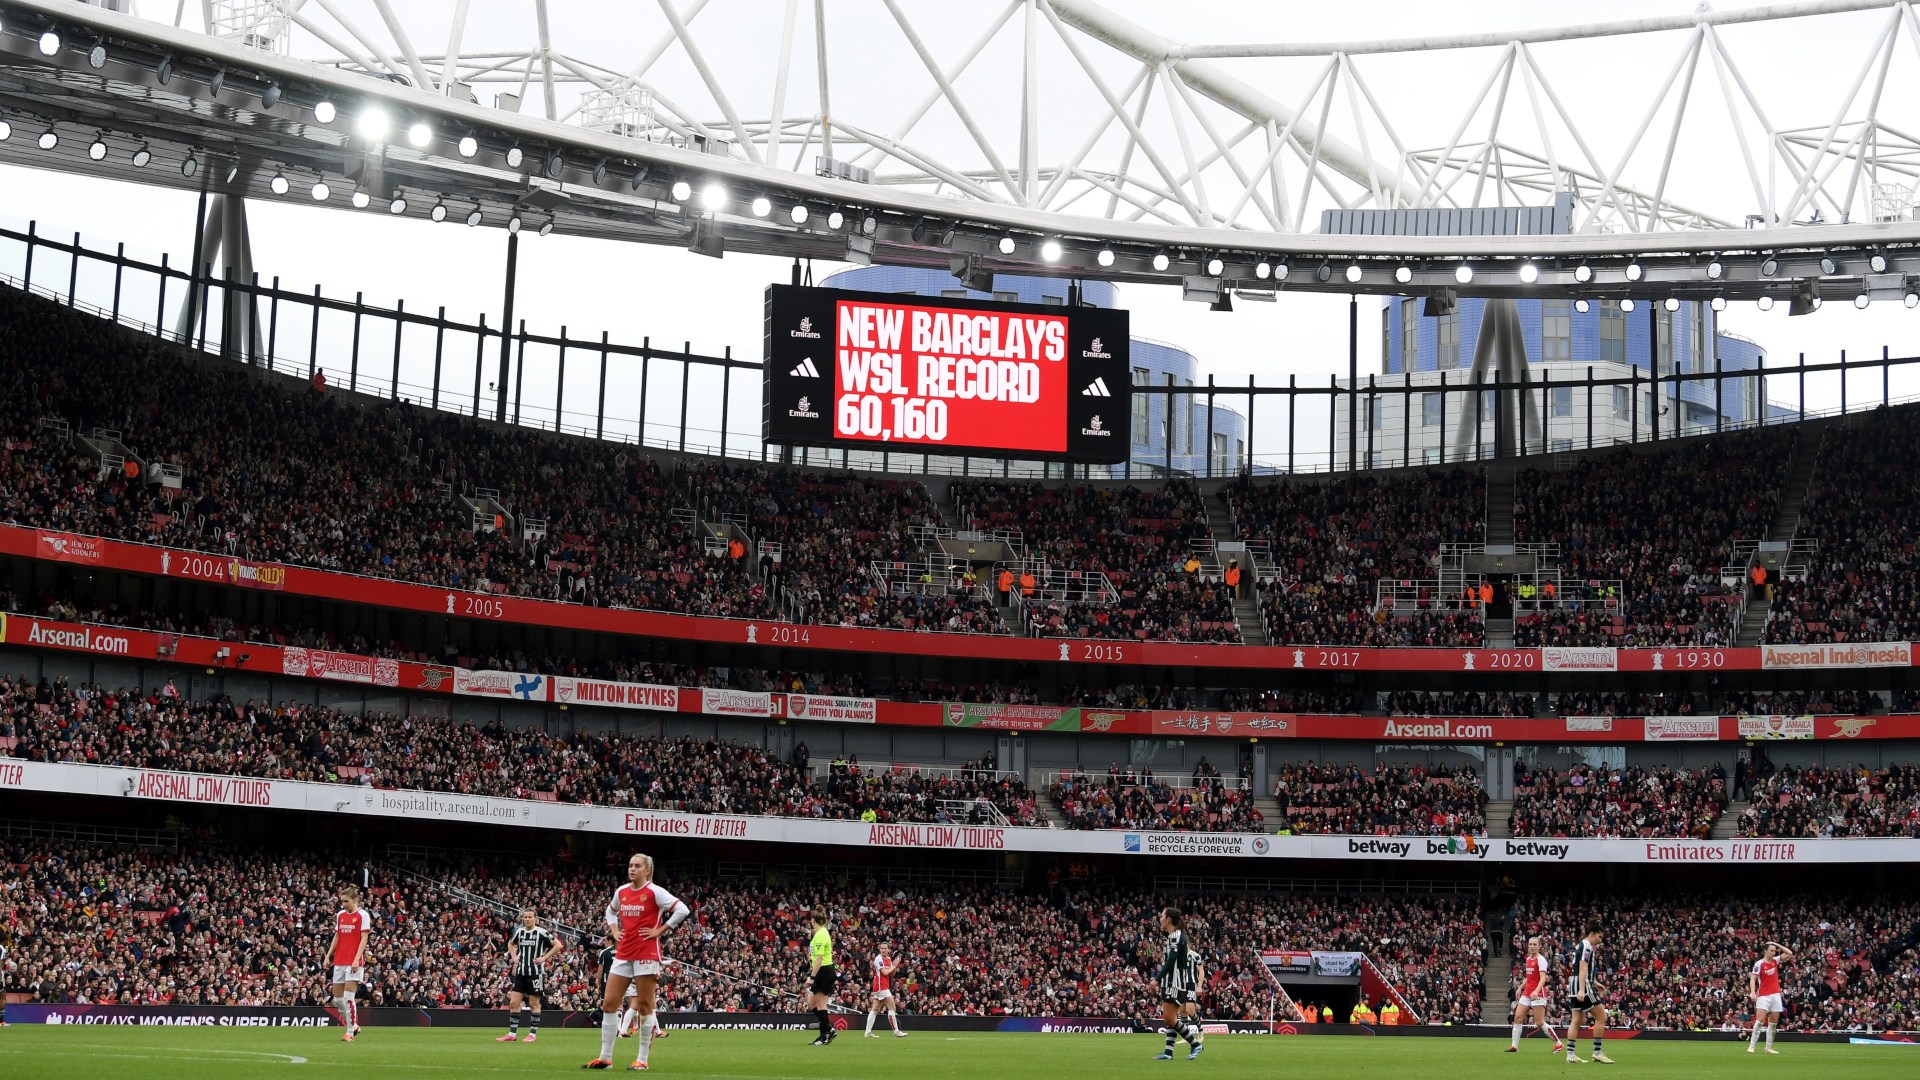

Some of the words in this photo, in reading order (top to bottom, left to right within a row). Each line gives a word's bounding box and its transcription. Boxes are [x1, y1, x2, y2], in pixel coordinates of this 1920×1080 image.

[790, 329, 821, 339] Emirates
[839, 305, 905, 350] NEW
[912, 311, 1065, 361] BARCLAYS
[1082, 349, 1112, 359] Emirates
[840, 350, 908, 395] WSL
[917, 355, 1040, 403] RECORD
[789, 409, 819, 419] Emirates
[837, 393, 948, 441] 60,160
[1081, 427, 1111, 437] Emirates
[71, 541, 95, 550] JEWISH
[71, 549, 100, 558] GOONERS
[181, 556, 224, 579] 2004
[239, 565, 257, 580] YOURS
[465, 597, 503, 618] 2005
[28, 622, 129, 653] Arsenal.com
[771, 627, 810, 643] 2014
[1084, 645, 1123, 660] 2015
[1319, 651, 1360, 667] 2017
[1490, 653, 1534, 668] 2020
[1562, 649, 1614, 663] Arsenal
[1676, 652, 1724, 667] 1930
[1765, 648, 1825, 665] Arsenal
[326, 654, 373, 675] Arsenal
[470, 670, 512, 688] Arsenal
[577, 681, 625, 703] MILTON
[628, 686, 676, 707] KEYNES
[721, 692, 769, 709] Arsenal
[808, 698, 834, 707] ARSENAL
[835, 700, 852, 708] SOUTH
[854, 701, 874, 709] AFRICA
[809, 708, 827, 717] WITH
[829, 709, 843, 718] YOU
[845, 710, 874, 720] ALWAYS
[969, 705, 1006, 717] ARSENAL
[1007, 707, 1062, 719] BANGLADESH
[1161, 714, 1212, 732] 一生槍手
[1236, 716, 1288, 730] 一世紅白
[1384, 720, 1493, 738] Arsenal.com
[1663, 718, 1718, 733] Arsenal
[1740, 721, 1766, 729] ARSENAL
[1785, 721, 1812, 729] JAMAICA
[138, 772, 271, 806] ARSENAL.COM/TOURS
[382, 794, 515, 820] hospitality.arsenal.com
[625, 813, 690, 834] Emirates
[695, 817, 712, 835] FLY
[713, 818, 747, 837] BETTER
[869, 824, 1004, 849] ARSENAL.COM/TOURS
[1148, 835, 1186, 844] CHOOSE
[1188, 836, 1245, 845] ALUMINIUM.
[1149, 845, 1196, 853] RECYCLES
[1198, 846, 1243, 854] FOREVER.
[1348, 838, 1411, 857] betway
[1426, 840, 1490, 859] beay
[1505, 841, 1569, 860] betway
[1646, 842, 1724, 860] Emirates
[1731, 844, 1752, 860] FLY
[1754, 843, 1795, 860] BETTER
